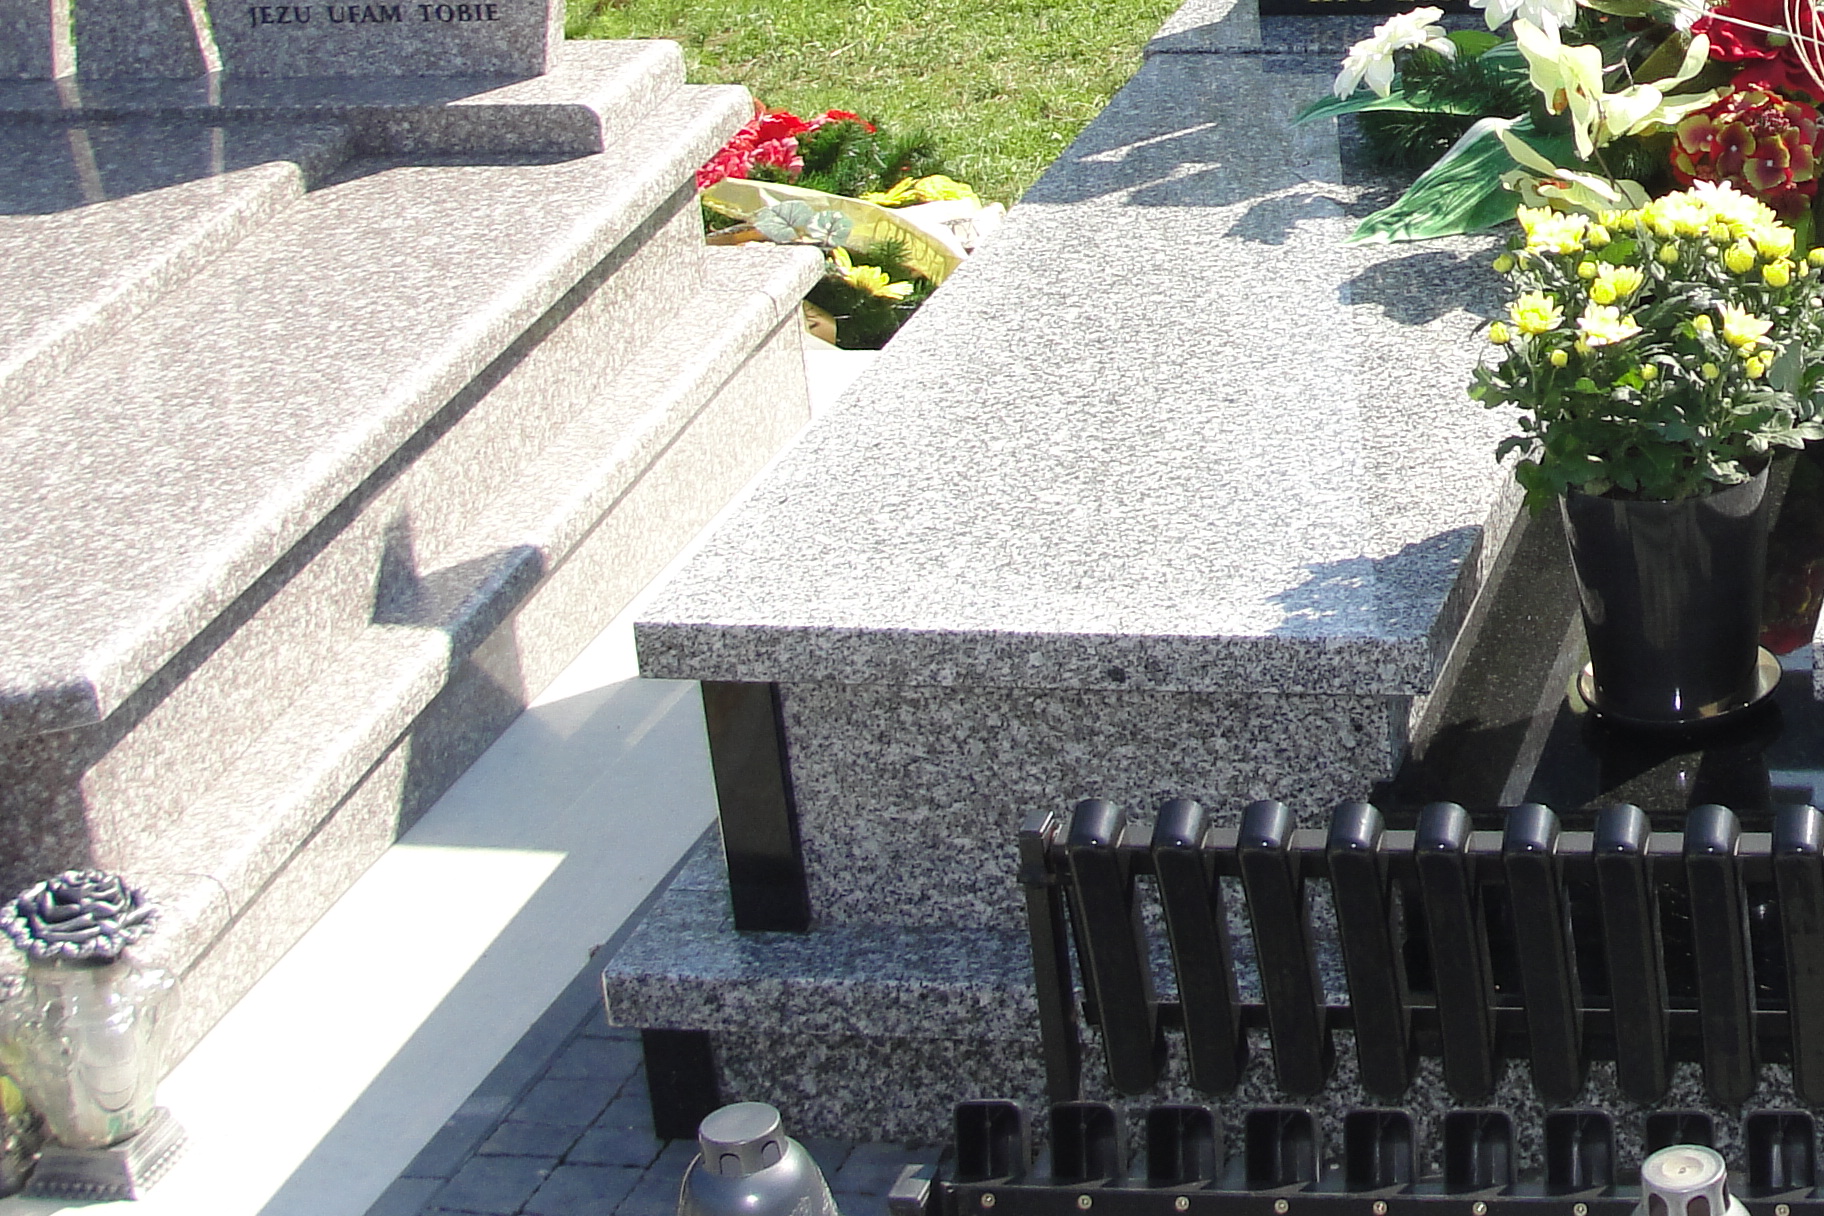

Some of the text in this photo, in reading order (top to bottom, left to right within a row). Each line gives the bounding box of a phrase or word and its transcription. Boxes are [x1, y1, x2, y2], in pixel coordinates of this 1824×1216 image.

[249, 3, 501, 28] JEZU UFAM TOBIE
